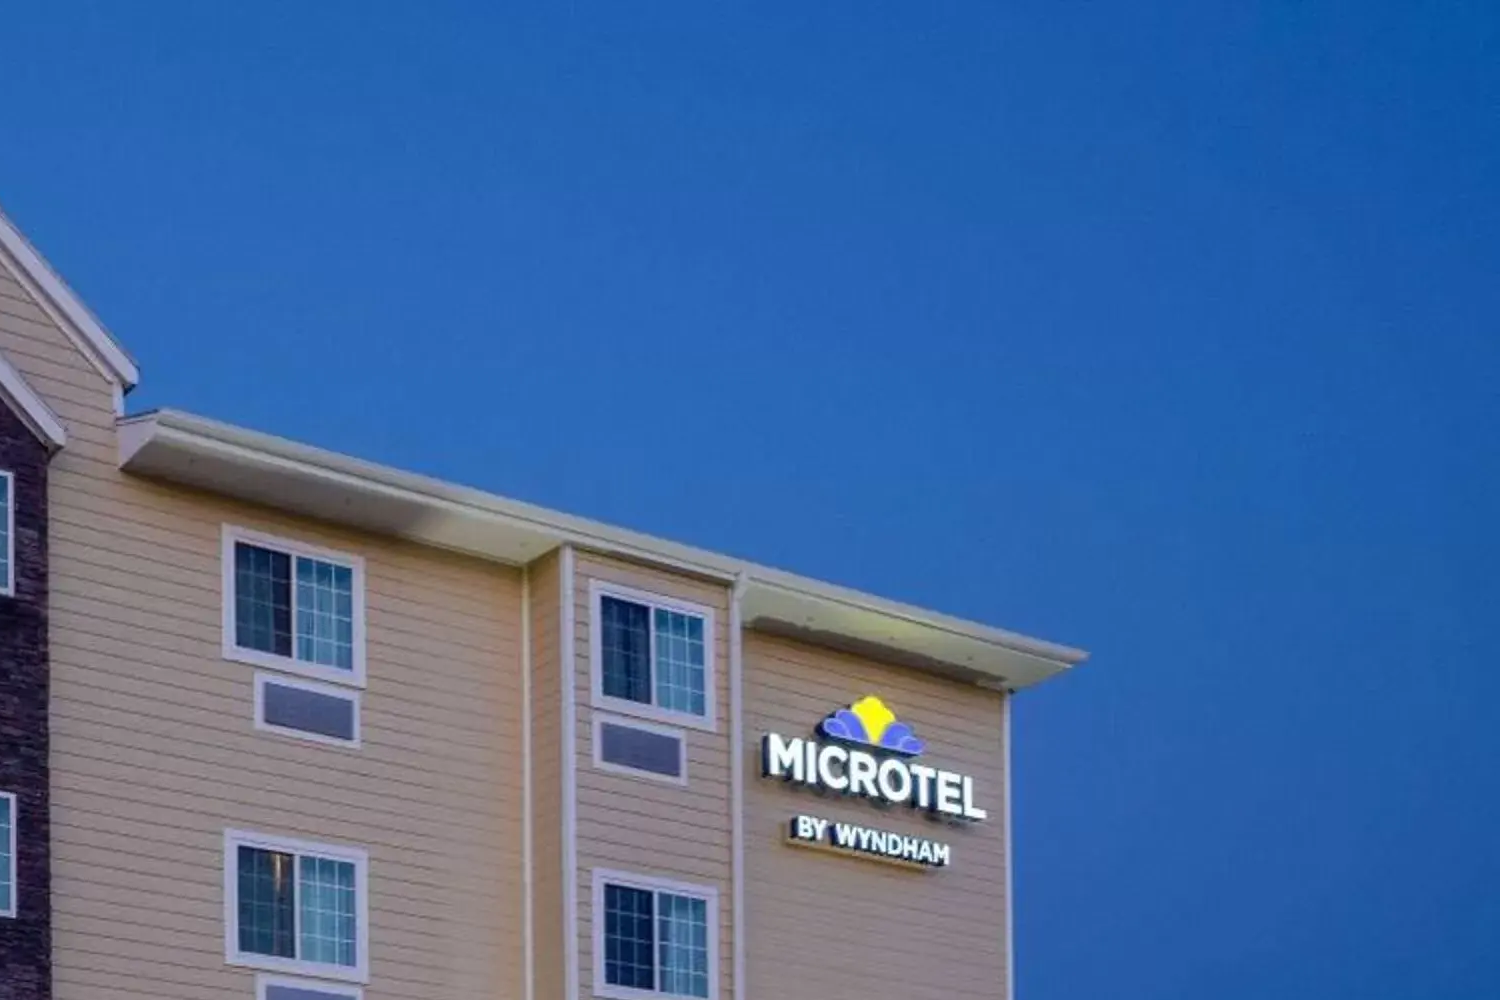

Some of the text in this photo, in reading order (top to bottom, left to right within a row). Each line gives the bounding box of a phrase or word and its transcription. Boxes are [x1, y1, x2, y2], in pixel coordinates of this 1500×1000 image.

[766, 733, 987, 820] MICROTEL
[797, 815, 950, 866] BY WYNDHAM
